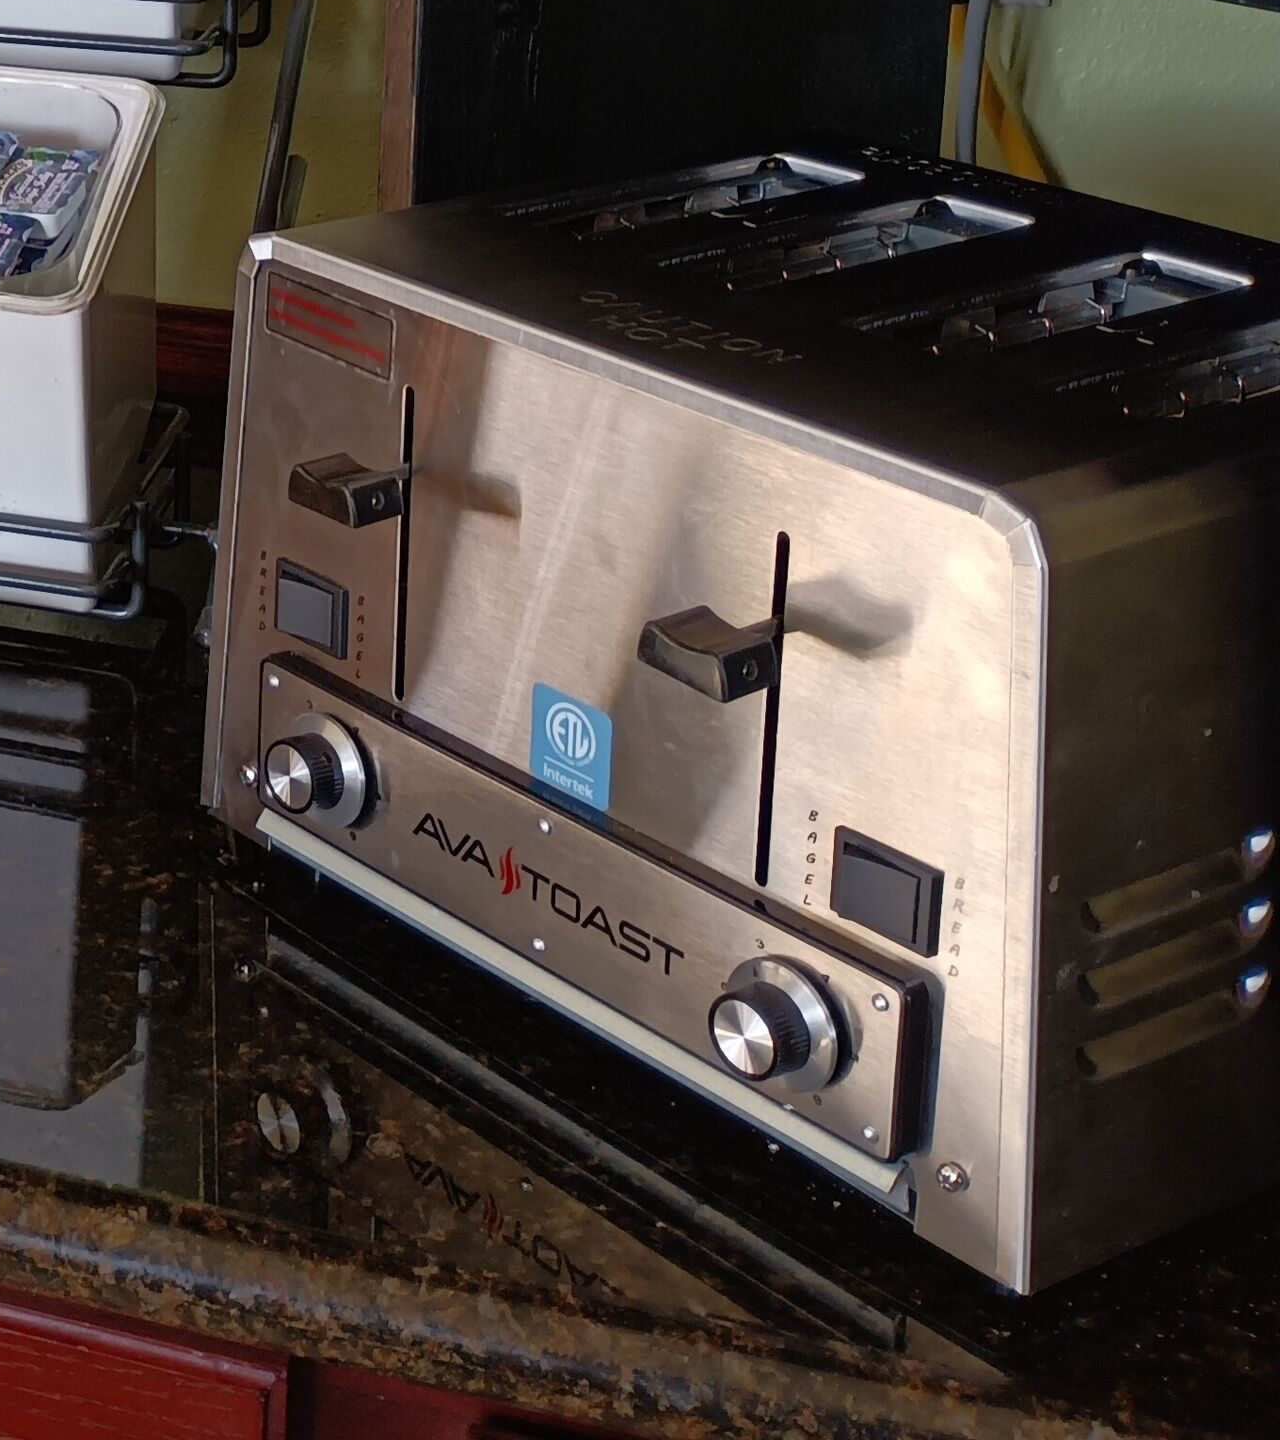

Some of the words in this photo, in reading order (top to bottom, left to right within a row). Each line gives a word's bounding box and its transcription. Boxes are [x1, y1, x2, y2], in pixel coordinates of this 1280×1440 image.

[586, 314, 706, 350] HOT
[258, 550, 267, 631] BREAD
[355, 595, 365, 680] BAGEL
[552, 711, 589, 759] ETL
[543, 762, 594, 800] Intertek
[412, 812, 495, 878] AVA
[521, 863, 685, 976] TOAST
[803, 810, 819, 906] BAGEL
[947, 876, 966, 978] BREAD
